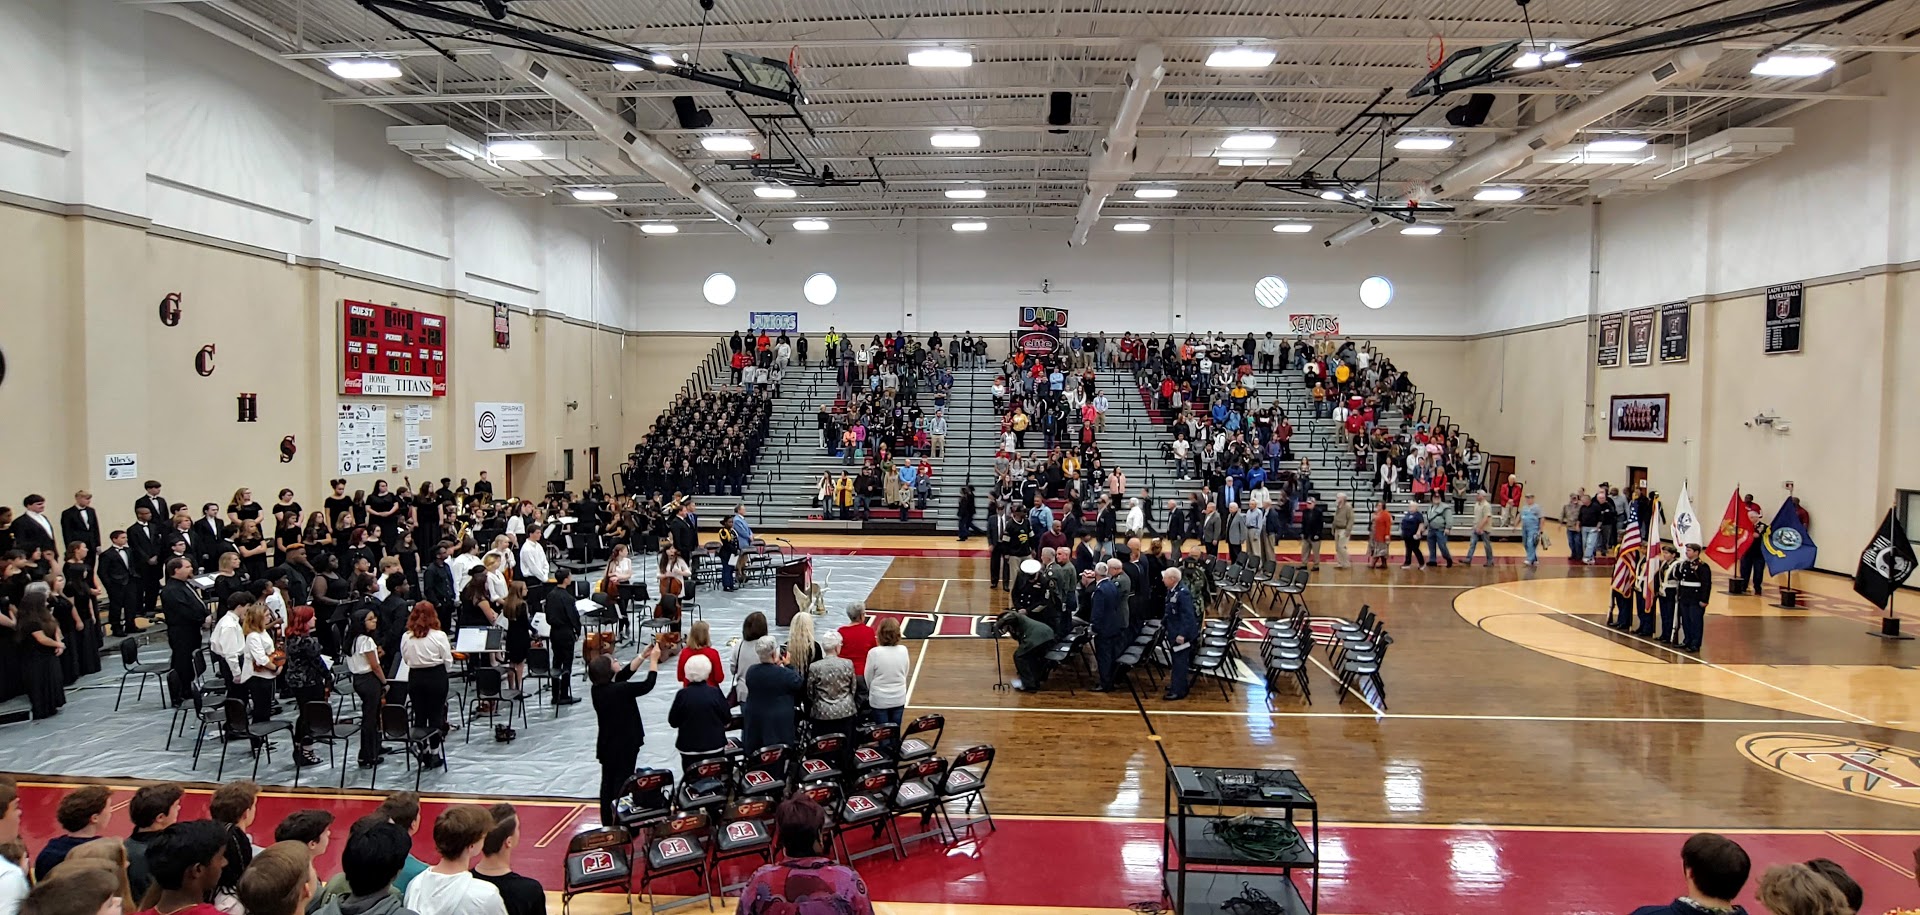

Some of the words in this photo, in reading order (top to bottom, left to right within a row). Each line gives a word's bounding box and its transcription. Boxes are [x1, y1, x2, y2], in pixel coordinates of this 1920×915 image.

[1768, 290, 1799, 300] BASKETBALL
[351, 305, 374, 317] GUEST
[1023, 307, 1067, 327] BAND
[752, 314, 796, 330] JUNIORS
[1292, 316, 1337, 332] SENIORS
[364, 385, 374, 393] OF
[377, 385, 391, 394] THE
[396, 378, 432, 393] TITANS
[368, 375, 386, 384] HOME
